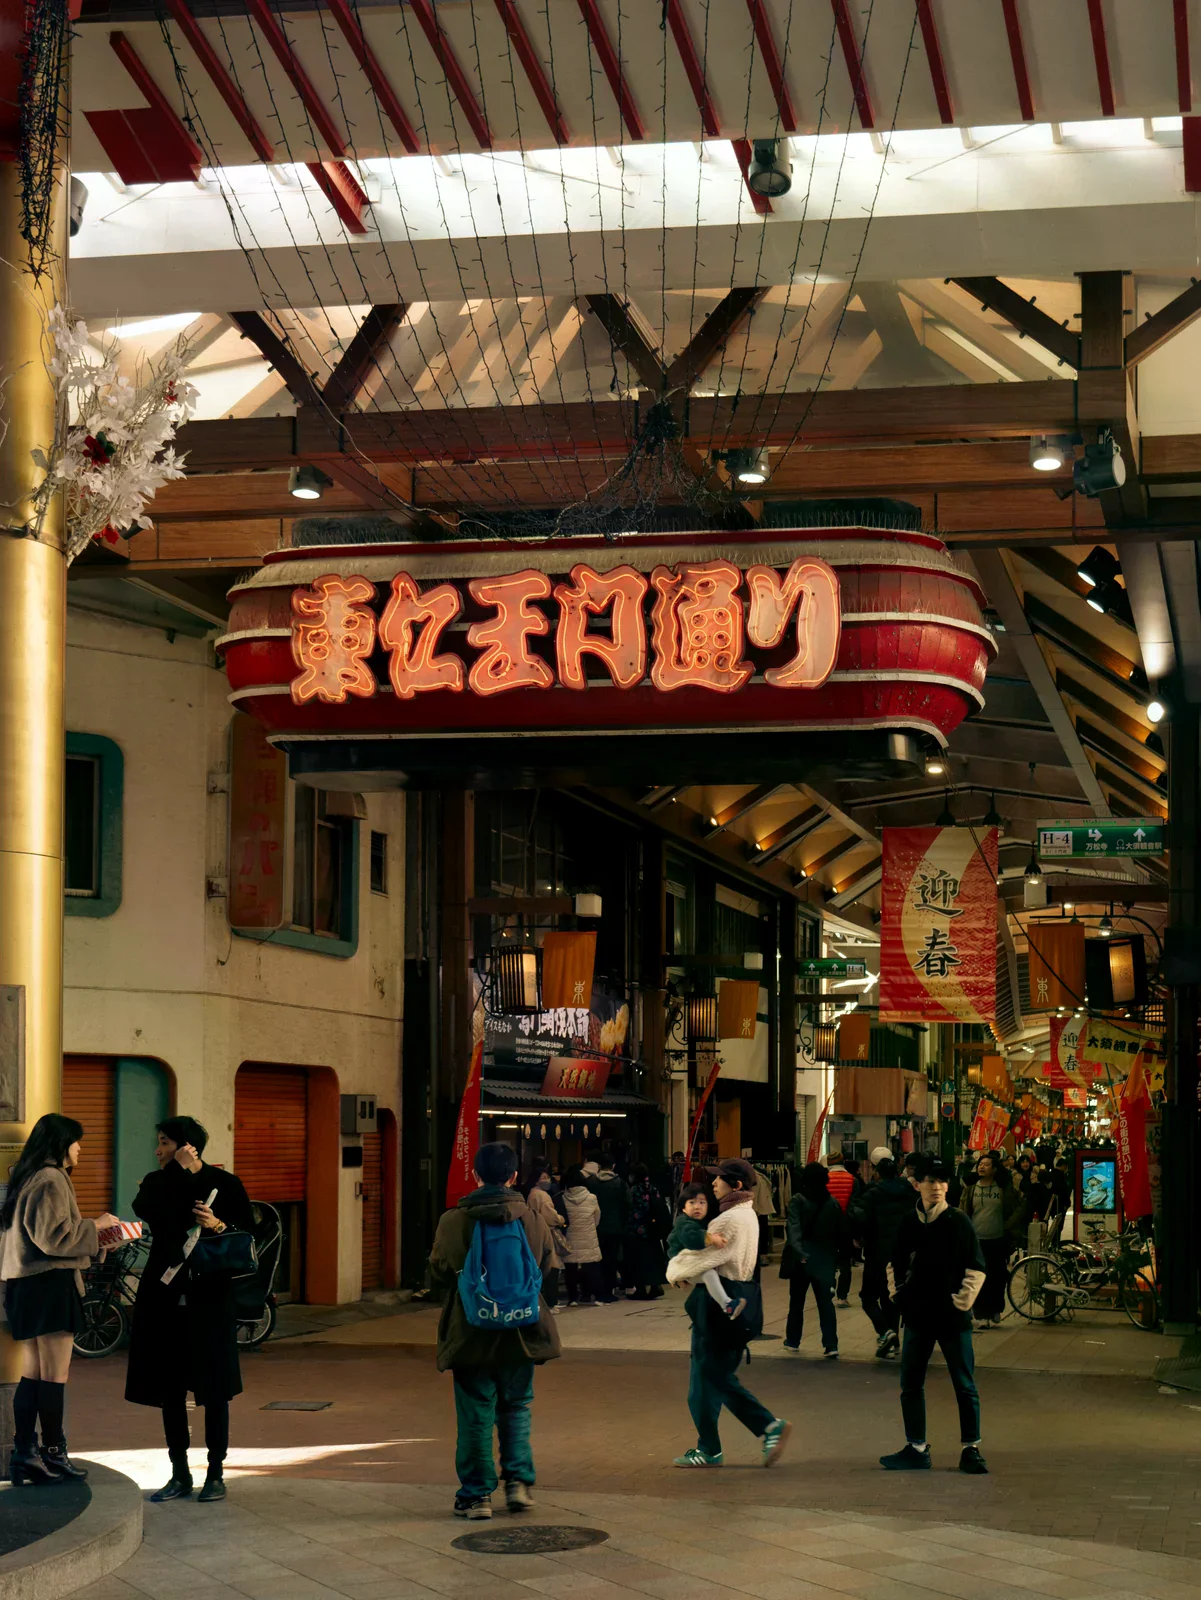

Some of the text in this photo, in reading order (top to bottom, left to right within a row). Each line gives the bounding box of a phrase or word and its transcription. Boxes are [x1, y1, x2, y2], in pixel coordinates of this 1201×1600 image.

[290, 556, 841, 704] 東仁王門通り
[1043, 833, 1070, 844] H-4
[913, 869, 964, 978] 迎春
[1062, 1032, 1080, 1071] 迎春
